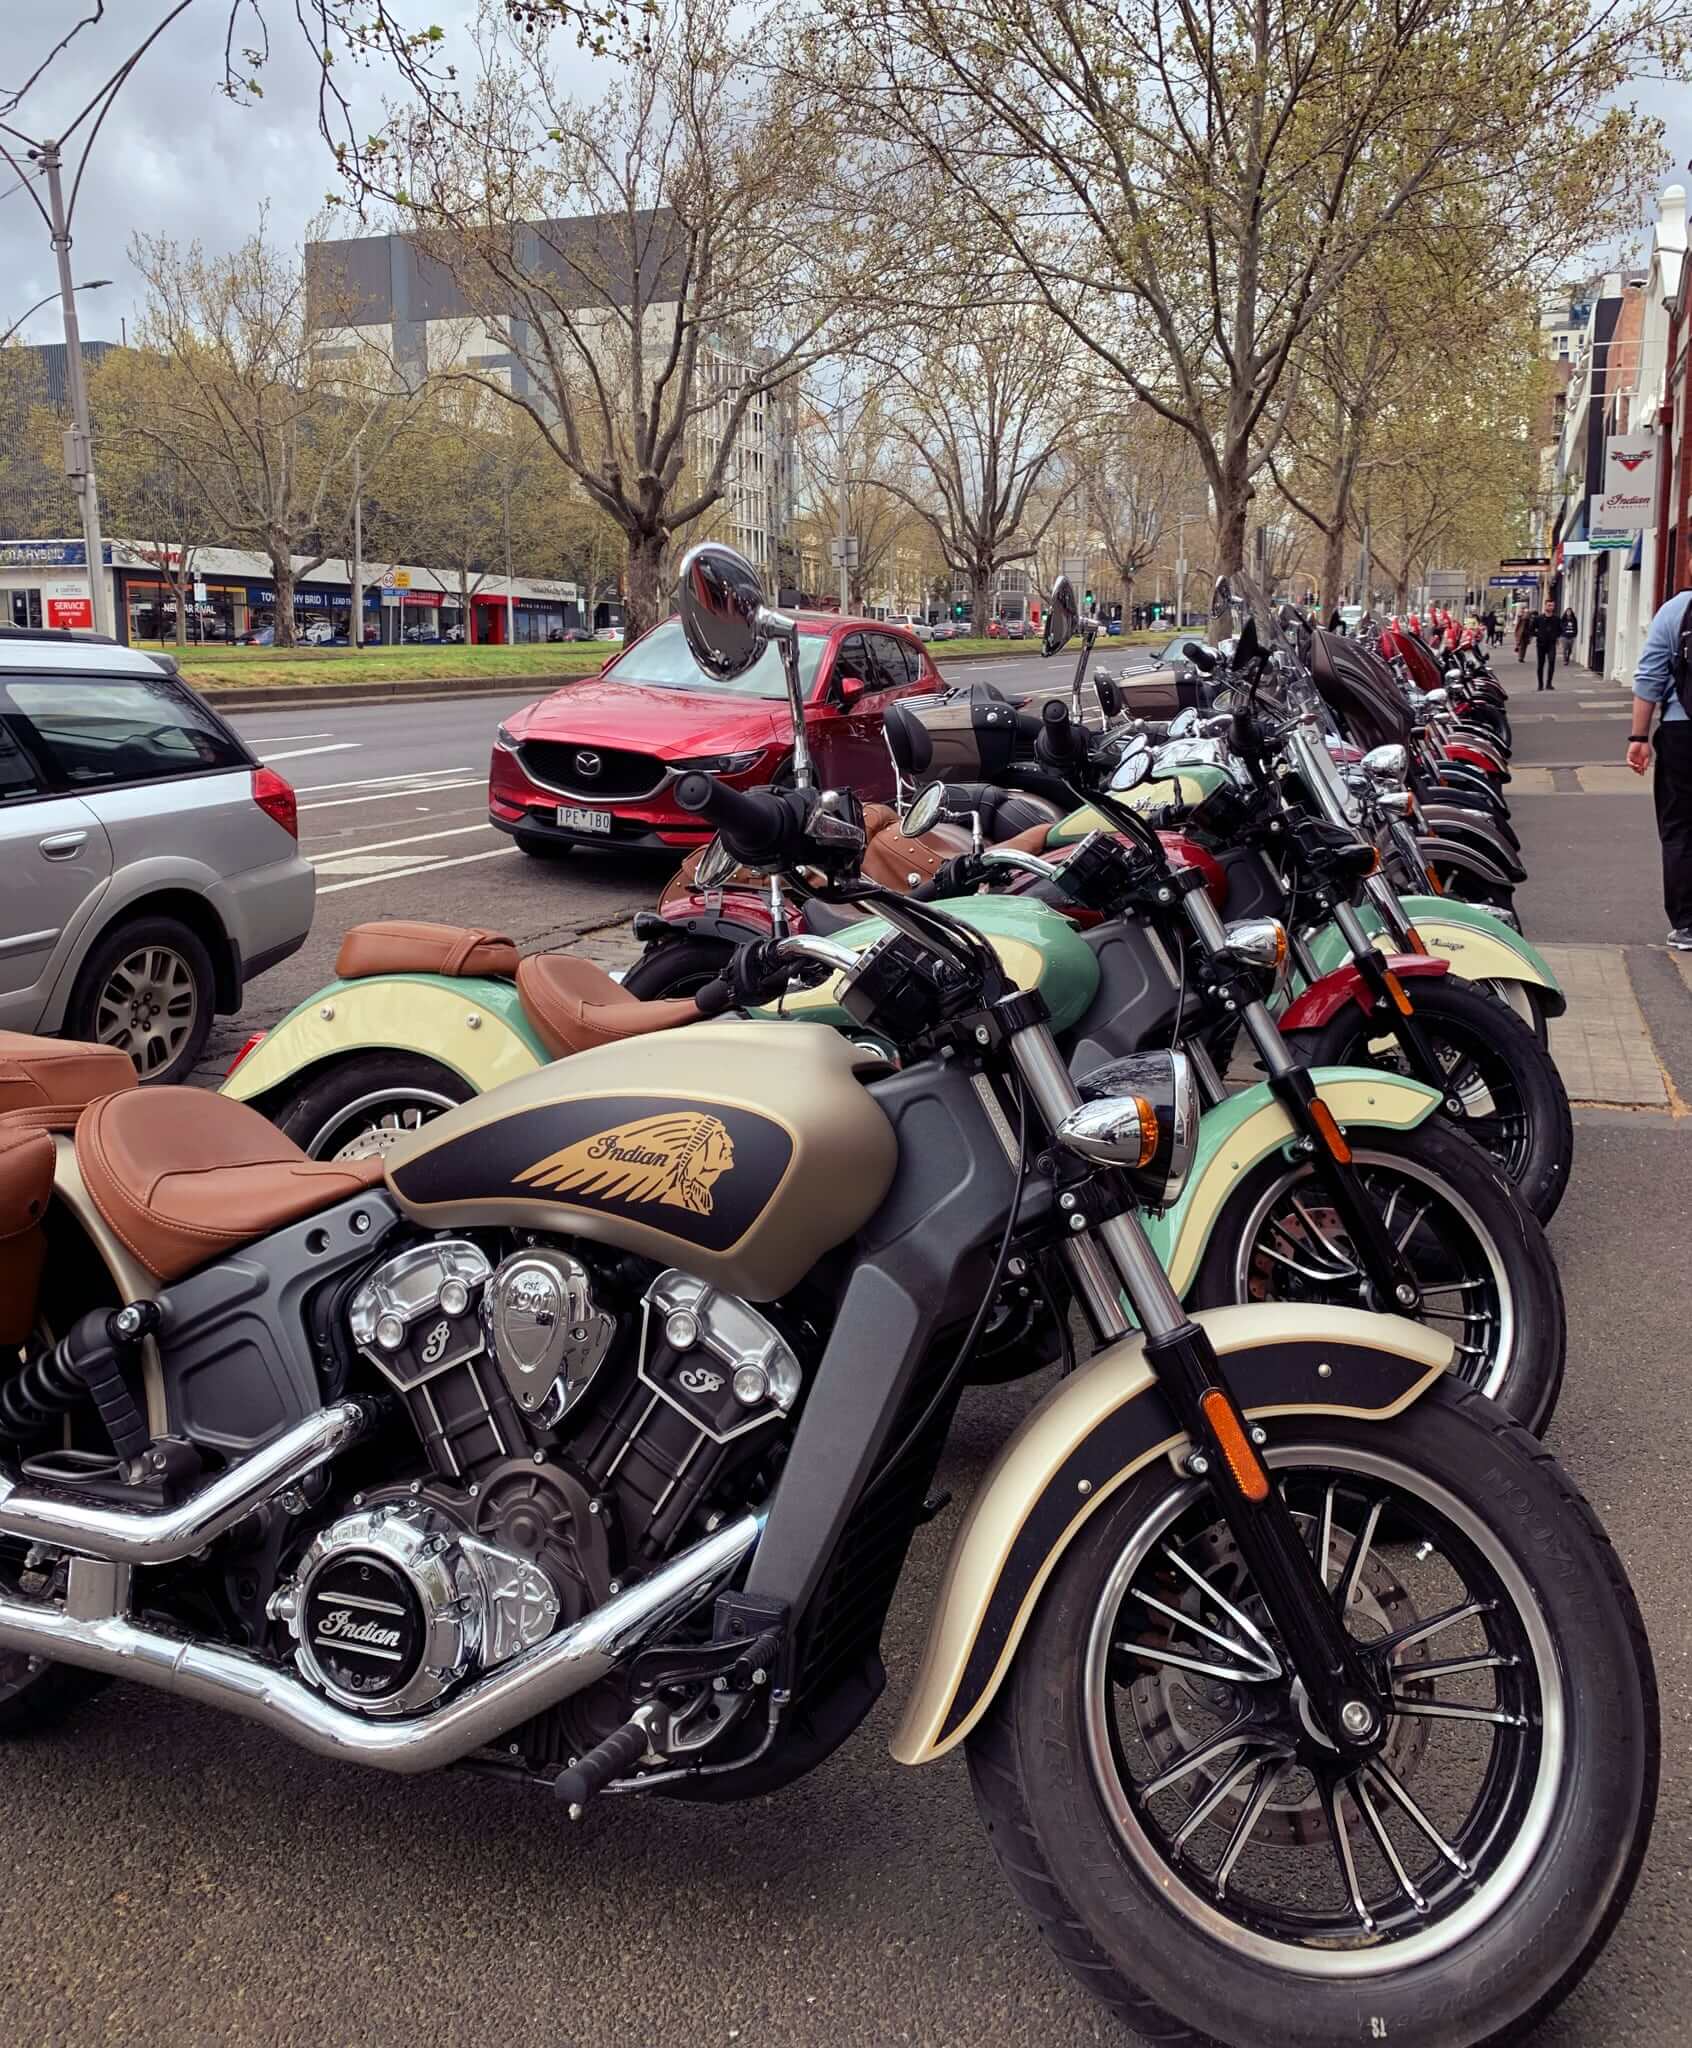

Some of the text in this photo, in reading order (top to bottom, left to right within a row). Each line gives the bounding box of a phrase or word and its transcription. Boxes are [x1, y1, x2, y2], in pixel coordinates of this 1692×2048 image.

[1607, 493, 1650, 505] Indian
[54, 601, 85, 610] SERVICE
[588, 1136, 669, 1168] Indian
[317, 1610, 401, 1647] Indian
